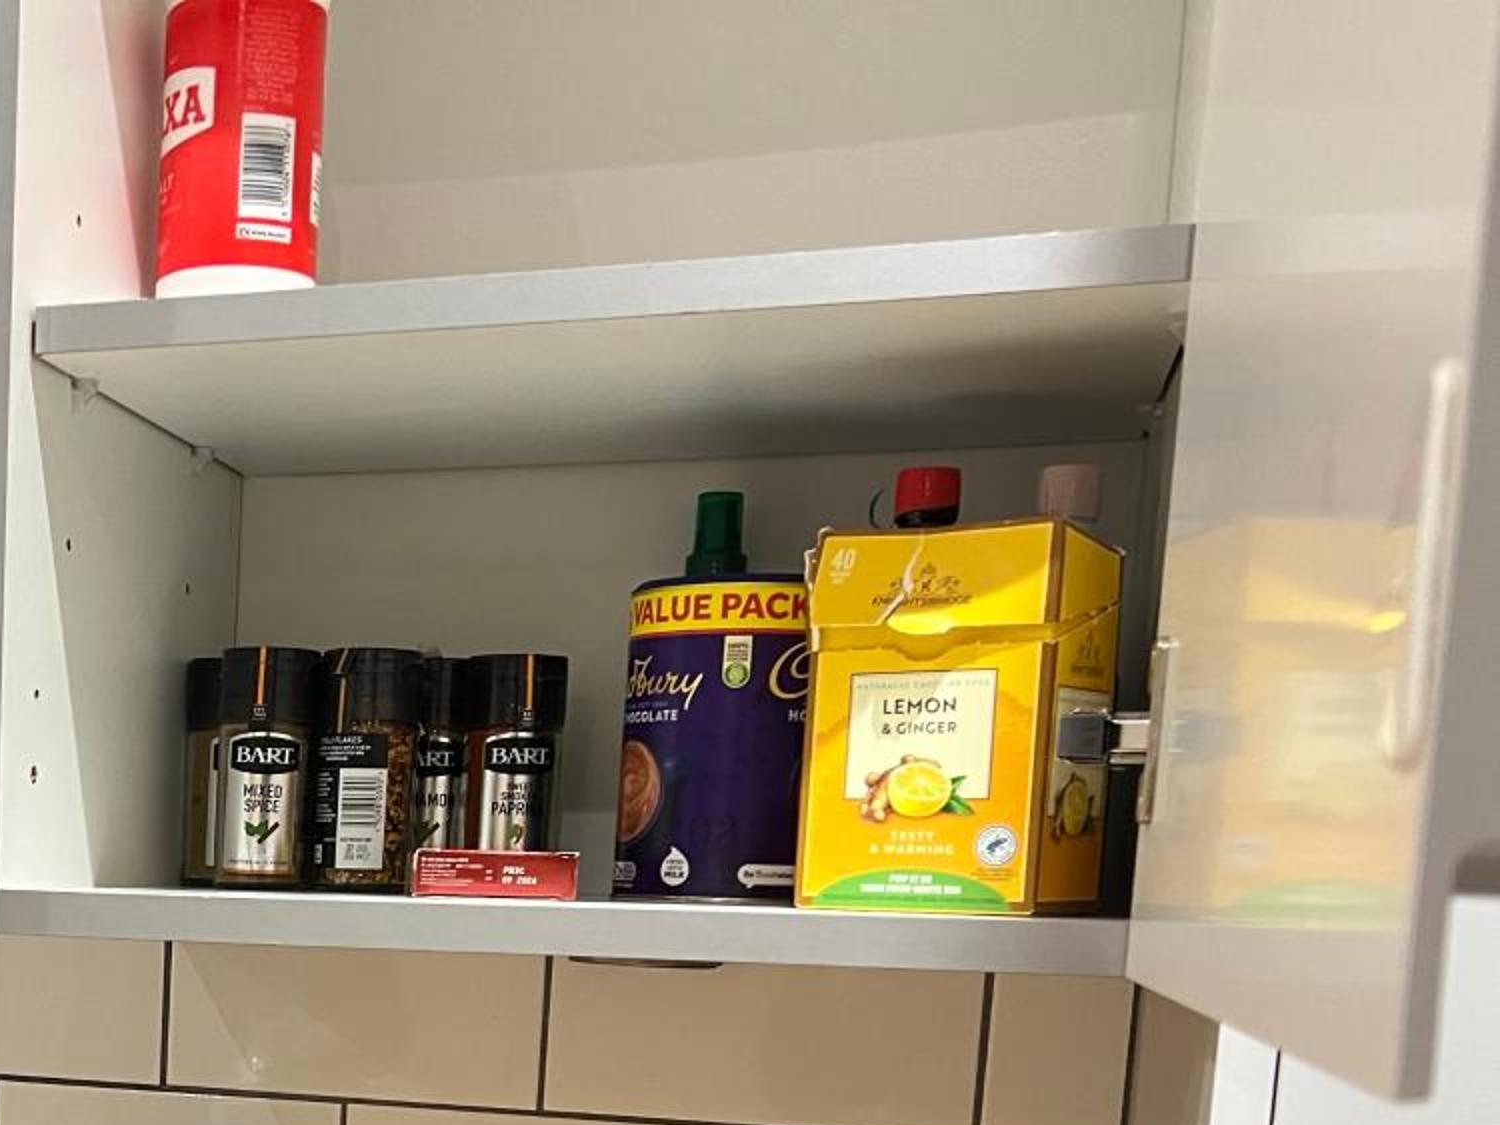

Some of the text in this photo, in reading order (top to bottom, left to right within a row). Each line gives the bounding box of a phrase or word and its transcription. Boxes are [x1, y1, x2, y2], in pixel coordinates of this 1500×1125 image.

[633, 592, 807, 627] VALUE PACK
[883, 697, 958, 715] LEMON
[881, 721, 958, 735] & GINGER
[236, 746, 296, 765] BART
[417, 750, 455, 767] ART
[491, 747, 549, 765] BART
[243, 783, 283, 799] MIXED
[243, 799, 280, 813] SPICE
